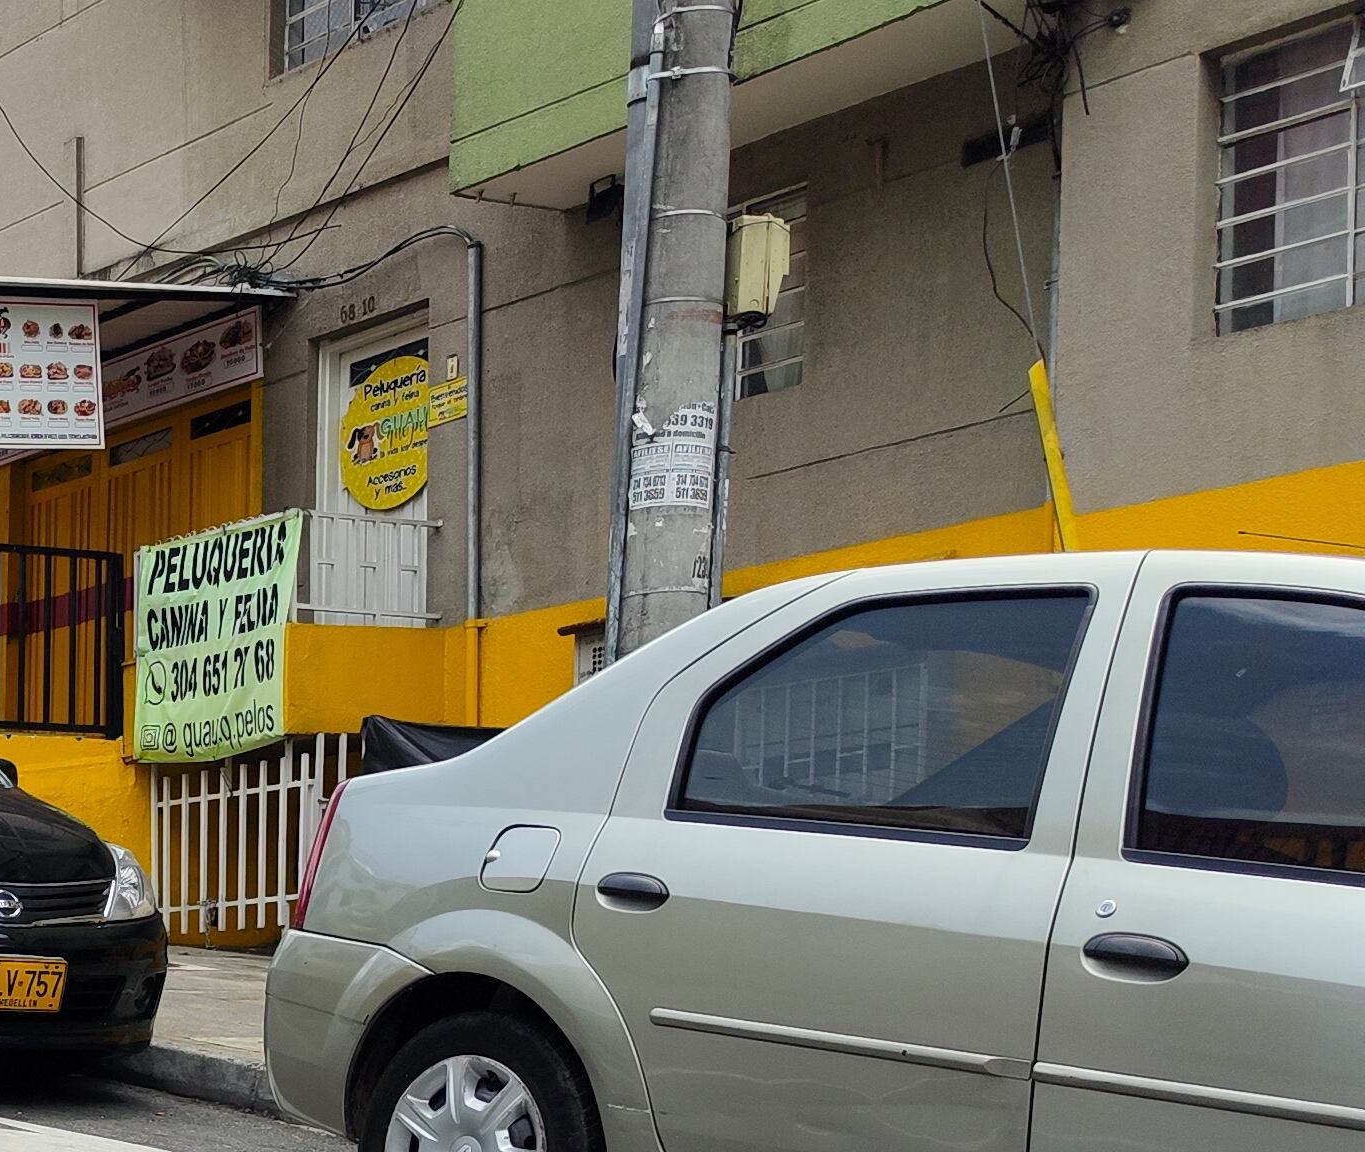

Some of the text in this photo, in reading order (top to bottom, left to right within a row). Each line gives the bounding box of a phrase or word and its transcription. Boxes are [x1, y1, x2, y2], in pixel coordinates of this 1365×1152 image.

[340, 303, 355, 324] 68
[364, 364, 426, 401] Peluquería
[690, 414, 714, 430] 3319
[367, 464, 417, 487] Accesorios
[146, 521, 287, 596] PELUQUERIA
[147, 583, 279, 652] CANINA Y FELINA
[170, 657, 198, 703] 304
[202, 650, 228, 697] 651
[254, 638, 275, 684] 68
